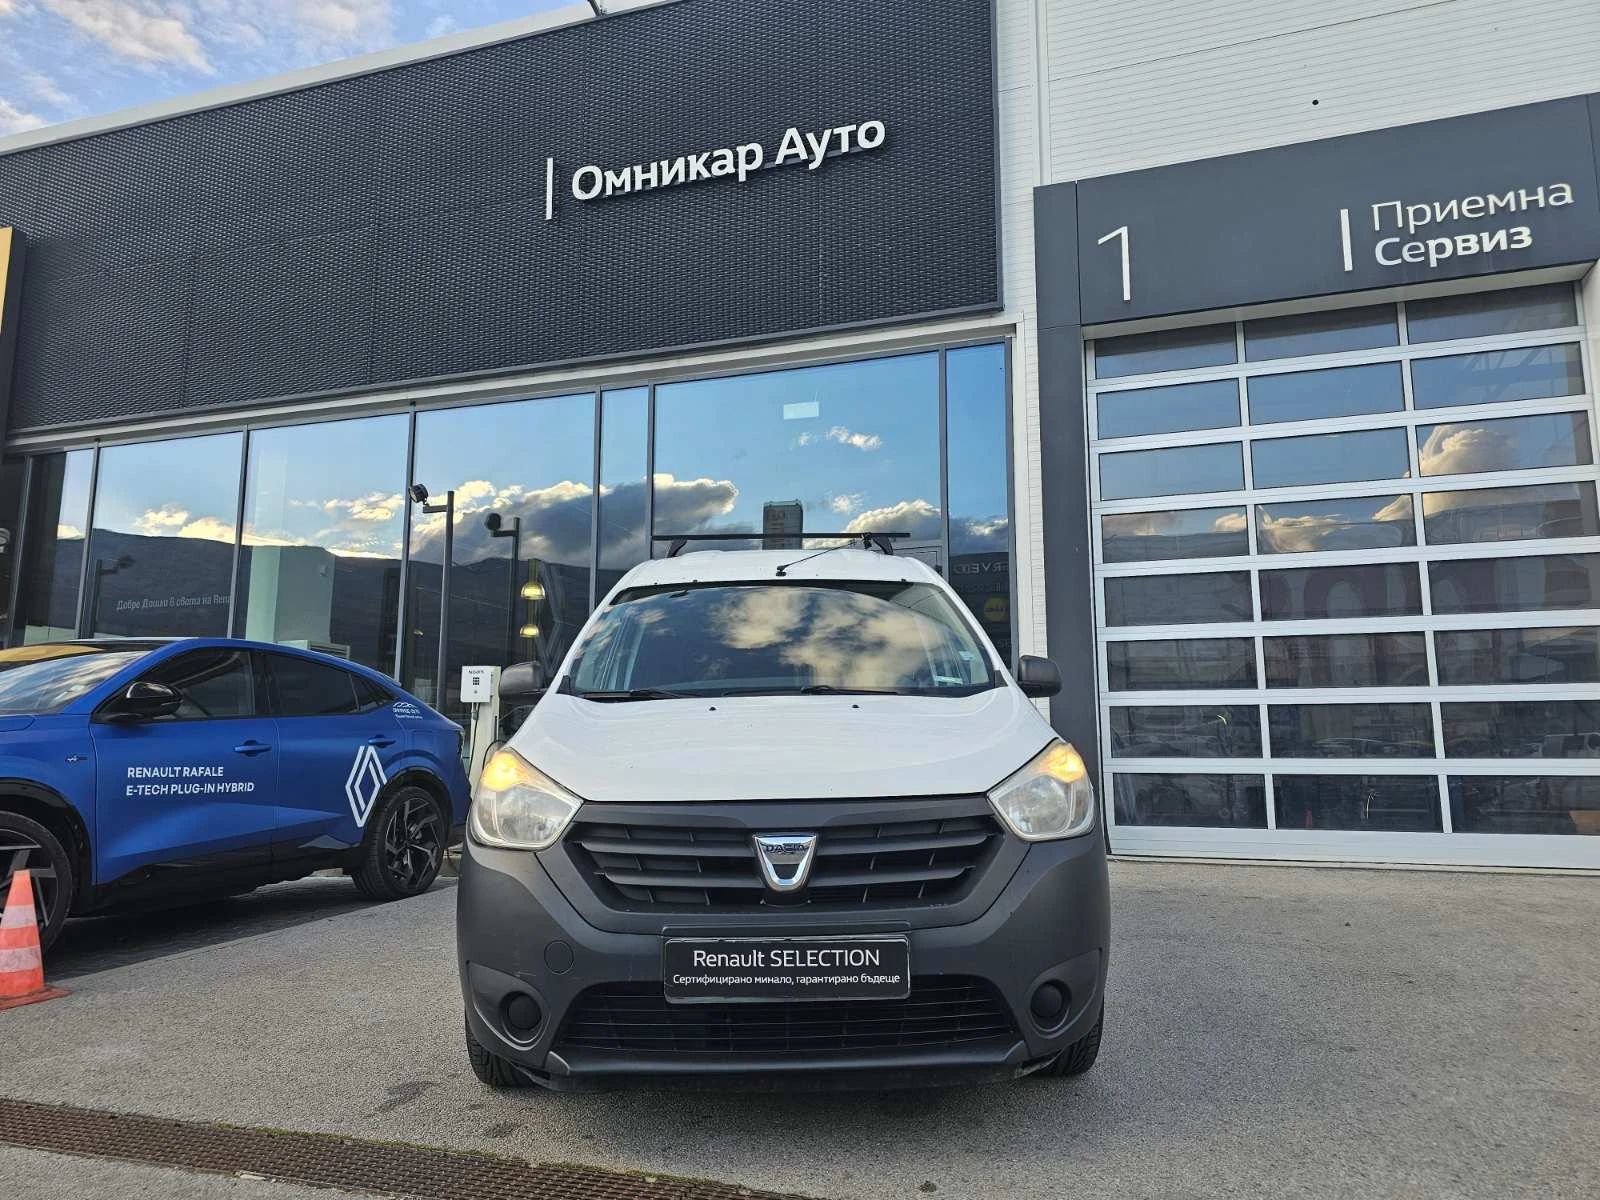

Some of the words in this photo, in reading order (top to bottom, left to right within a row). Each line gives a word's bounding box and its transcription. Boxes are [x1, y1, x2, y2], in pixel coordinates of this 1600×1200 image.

[572, 141, 763, 200] Омникар
[776, 120, 885, 170] Ауто
[1371, 183, 1575, 235] Приемна
[1374, 226, 1533, 268] Сервиз
[1098, 226, 1131, 301] 1
[127, 767, 181, 778] RENAULT
[182, 766, 224, 777] RAFALE
[126, 784, 169, 796] E-TECH
[170, 783, 215, 795] PLUG-IN
[217, 782, 255, 793] HYBRID
[765, 844, 807, 854] DACIA
[693, 949, 765, 967] Renault
[770, 949, 880, 967] SELECTION
[673, 974, 752, 986] Сертифицирано
[754, 975, 795, 985] минало,
[796, 974, 859, 985] гарантирано
[860, 973, 900, 984] бъдеще
